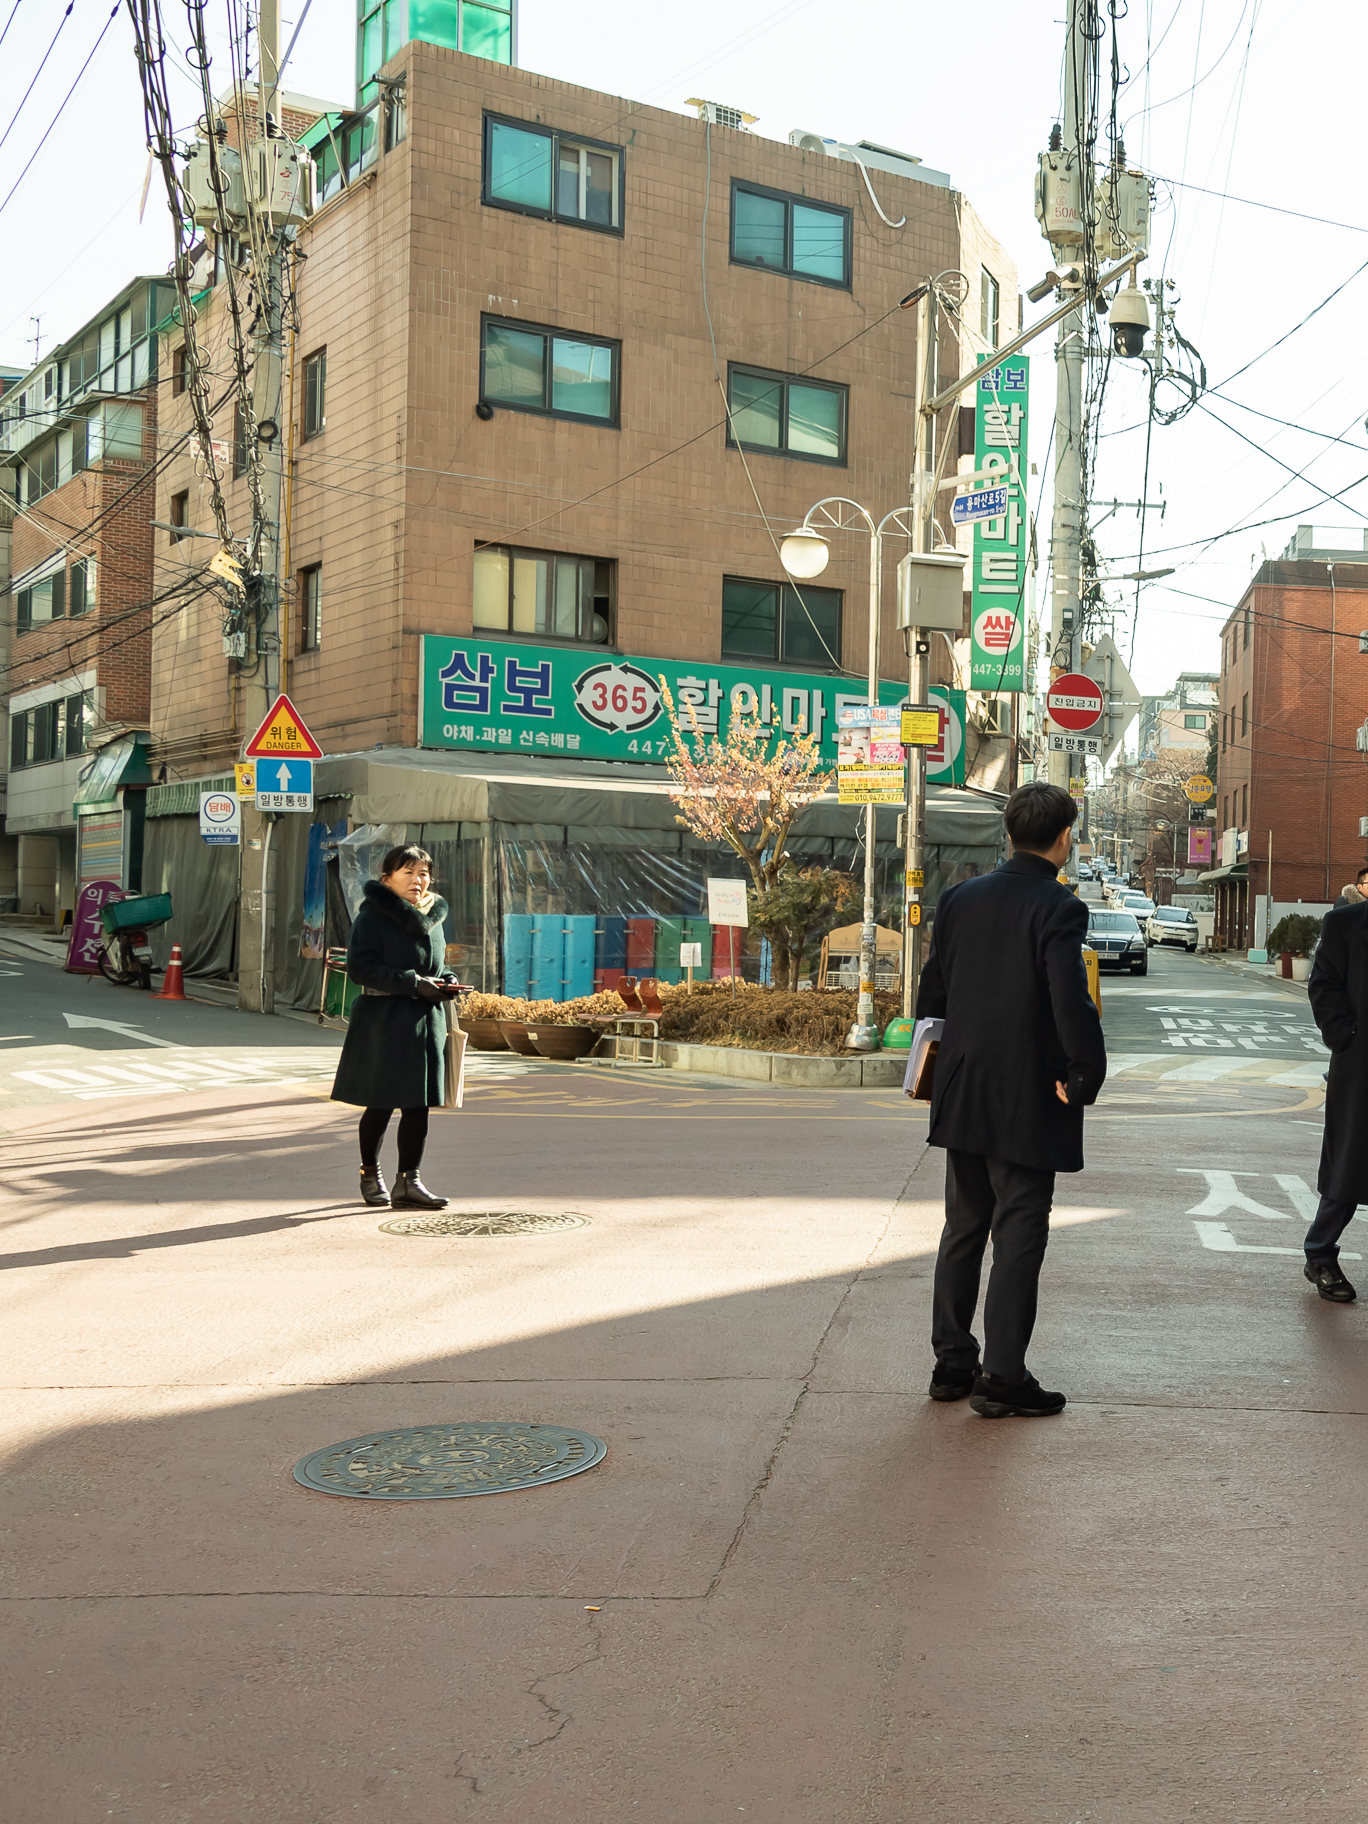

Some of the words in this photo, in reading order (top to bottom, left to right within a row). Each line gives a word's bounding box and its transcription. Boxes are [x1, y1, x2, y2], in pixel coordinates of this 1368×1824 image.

[978, 366, 1028, 393] 삼보
[966, 489, 1007, 511] 용마산로5길
[982, 614, 1014, 649] 쌀
[438, 651, 555, 719] 삼보
[592, 682, 649, 715] 365
[1053, 696, 1098, 709] 진입금지
[853, 708, 871, 720] USA
[269, 726, 298, 742] 위험
[519, 731, 582, 750] 신속배달
[266, 740, 302, 751] DANGER
[1052, 735, 1100, 754] 일방통행
[208, 802, 232, 814] 담배
[260, 794, 308, 808] 일방통행
